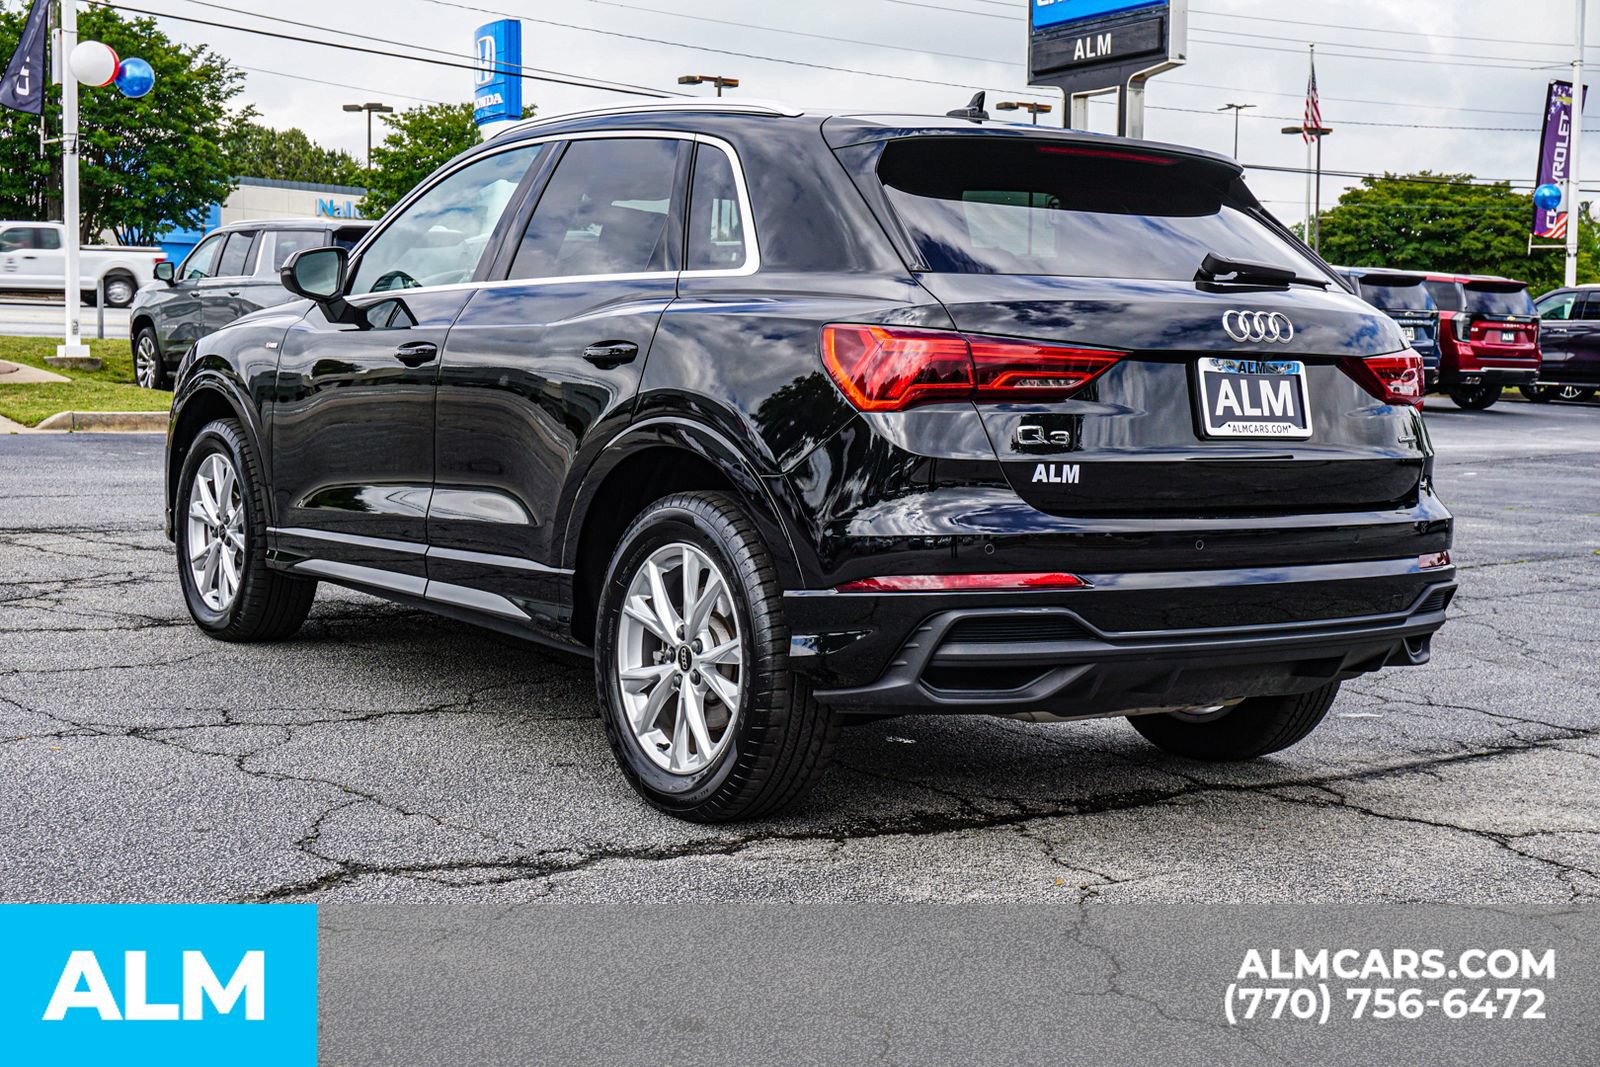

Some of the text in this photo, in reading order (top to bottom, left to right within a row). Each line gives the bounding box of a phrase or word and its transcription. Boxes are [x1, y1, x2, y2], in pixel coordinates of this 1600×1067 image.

[1073, 33, 1112, 60] ALM
[1546, 111, 1570, 228] CROLET
[1238, 361, 1266, 374] ALM
[1215, 378, 1295, 417] ALM
[1017, 425, 1071, 445] Q3
[1231, 424, 1289, 434] ALMCARS.COM
[1031, 463, 1080, 483] ALM
